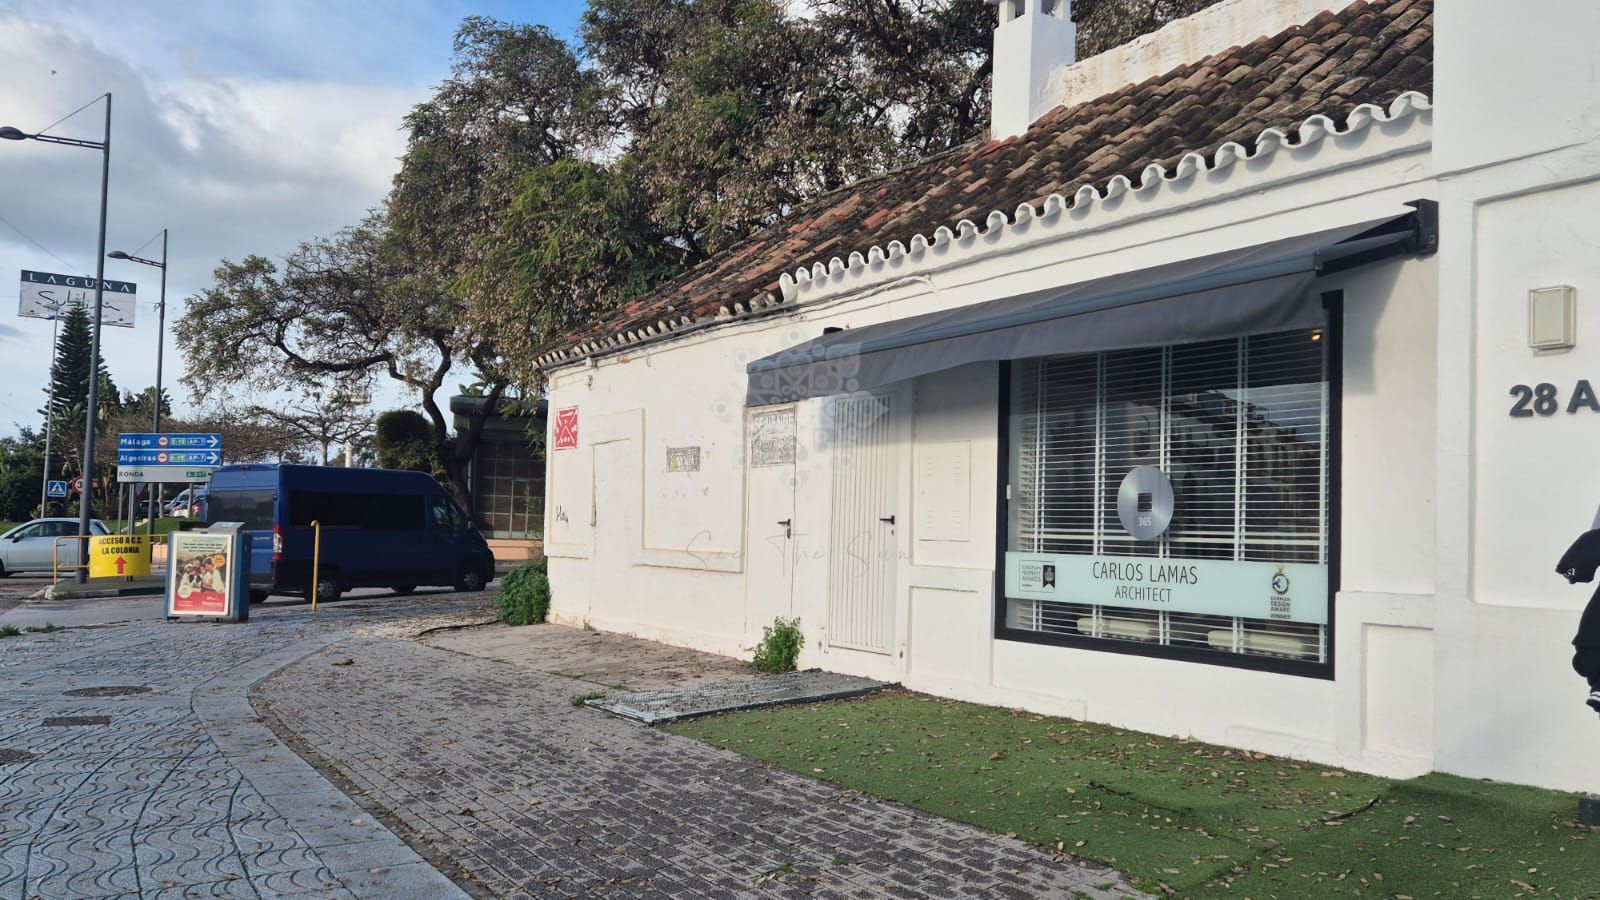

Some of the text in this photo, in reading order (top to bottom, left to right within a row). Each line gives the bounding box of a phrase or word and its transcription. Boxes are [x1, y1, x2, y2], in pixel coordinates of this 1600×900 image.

[29, 272, 130, 293] LAGUNA
[1508, 379, 1600, 417] 28 A
[120, 438, 151, 446] Málaga
[119, 455, 156, 463] Algeciras
[1138, 517, 1152, 526] 365
[111, 546, 139, 554] COLONIA
[1092, 561, 1198, 585] CARLOS LAMAS
[1114, 586, 1172, 603] ARCHITECT
